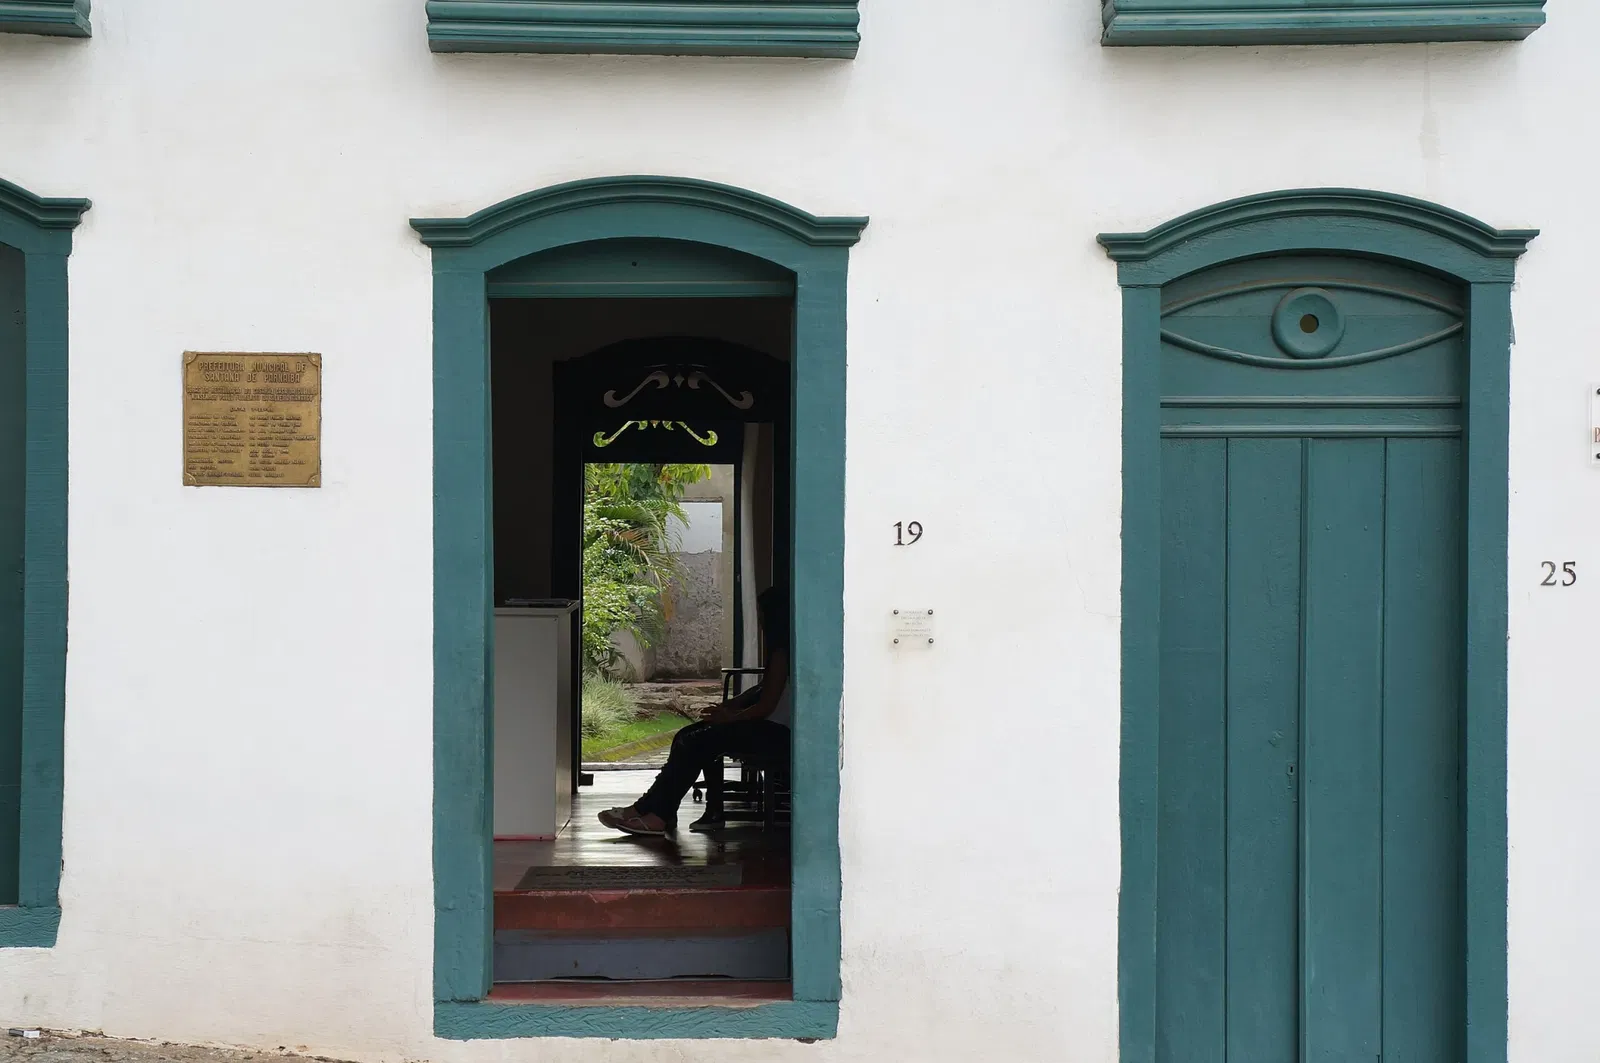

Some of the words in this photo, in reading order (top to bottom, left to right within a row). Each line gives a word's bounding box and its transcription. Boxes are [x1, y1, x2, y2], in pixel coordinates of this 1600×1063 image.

[296, 361, 306, 373] DE
[204, 372, 240, 383] SANTANA
[893, 521, 923, 546] 19
[1540, 561, 1577, 587] 25
